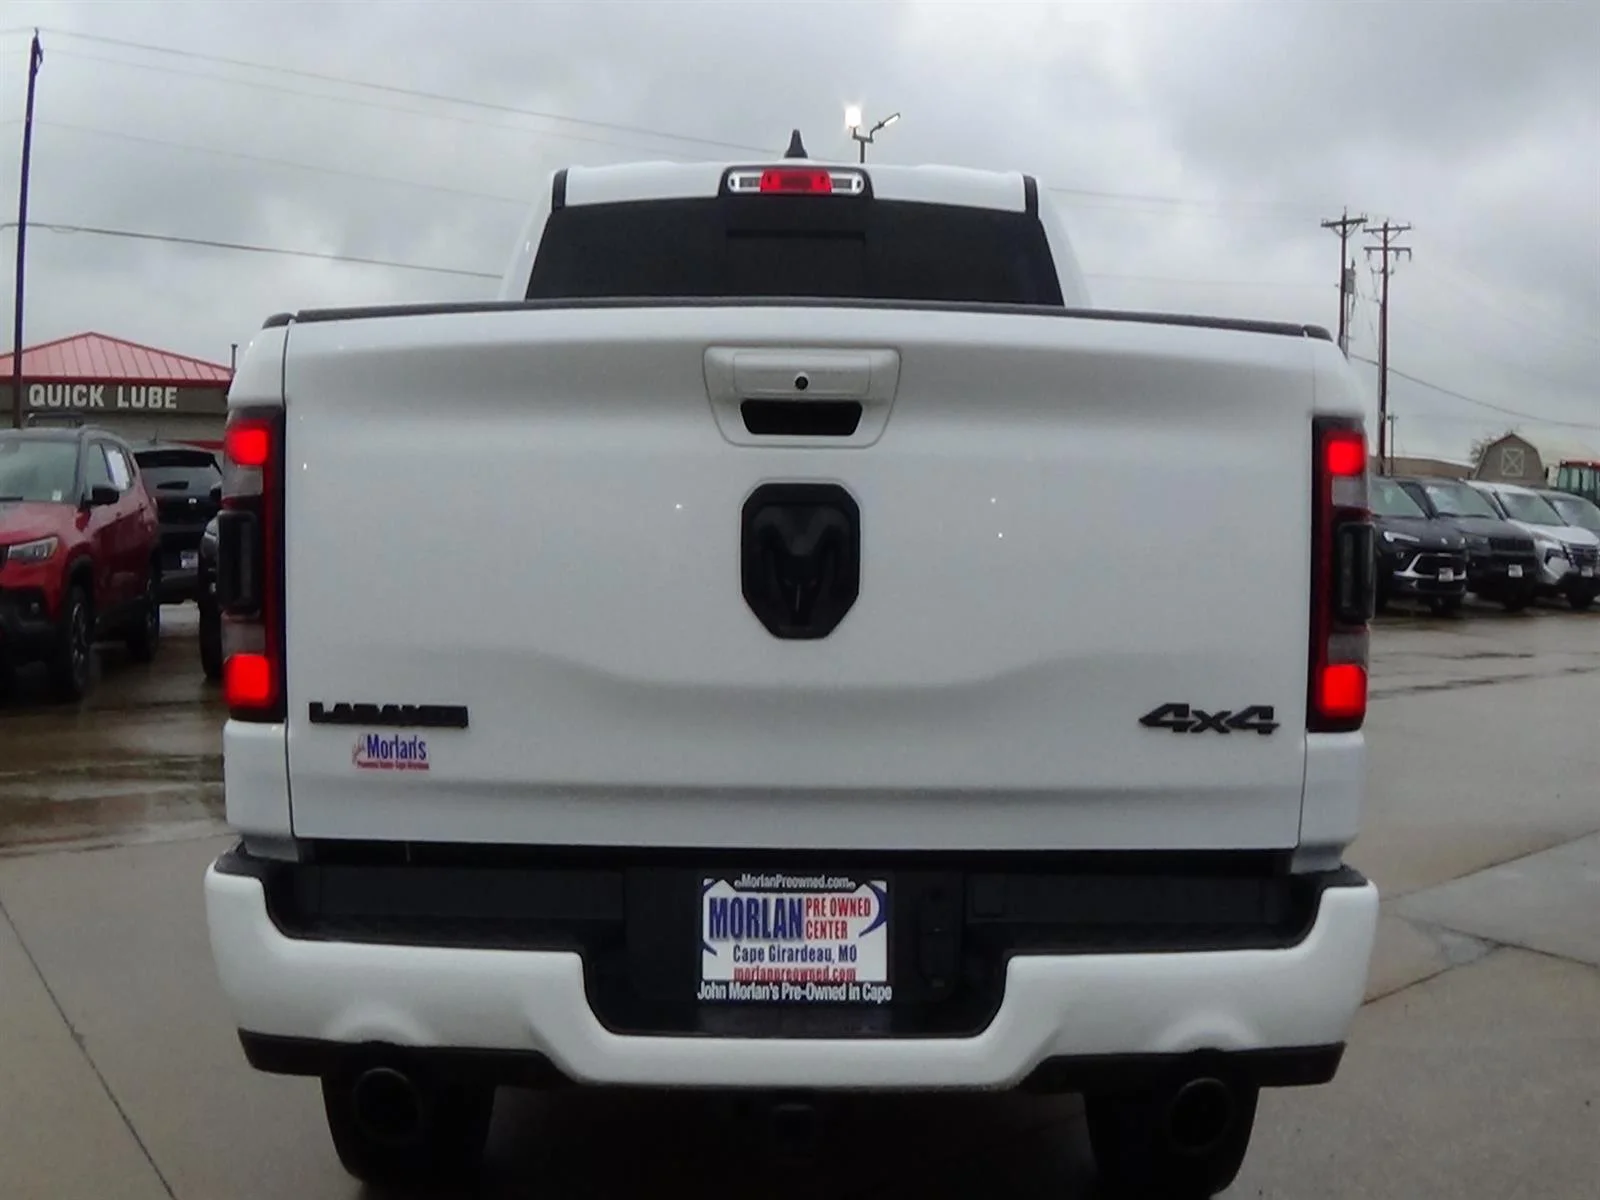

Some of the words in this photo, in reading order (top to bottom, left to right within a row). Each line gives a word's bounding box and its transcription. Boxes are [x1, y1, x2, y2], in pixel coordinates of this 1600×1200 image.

[28, 384, 105, 408] QUICK
[116, 386, 178, 409] LUBE
[308, 702, 469, 728] LARAM
[1138, 703, 1280, 734] 4x4
[367, 733, 427, 761] Morlan's
[708, 897, 804, 940] MORLAN
[805, 897, 827, 918] PRE
[829, 897, 871, 918] OWNED
[805, 920, 848, 940] CENTER
[732, 944, 765, 964] Cape
[768, 944, 835, 965] Girardeau,
[838, 945, 858, 963] MO
[697, 981, 727, 1001] John
[729, 981, 780, 1001] Morlan's
[782, 982, 847, 1001] Pre-Owned
[862, 982, 893, 1004] Cape
